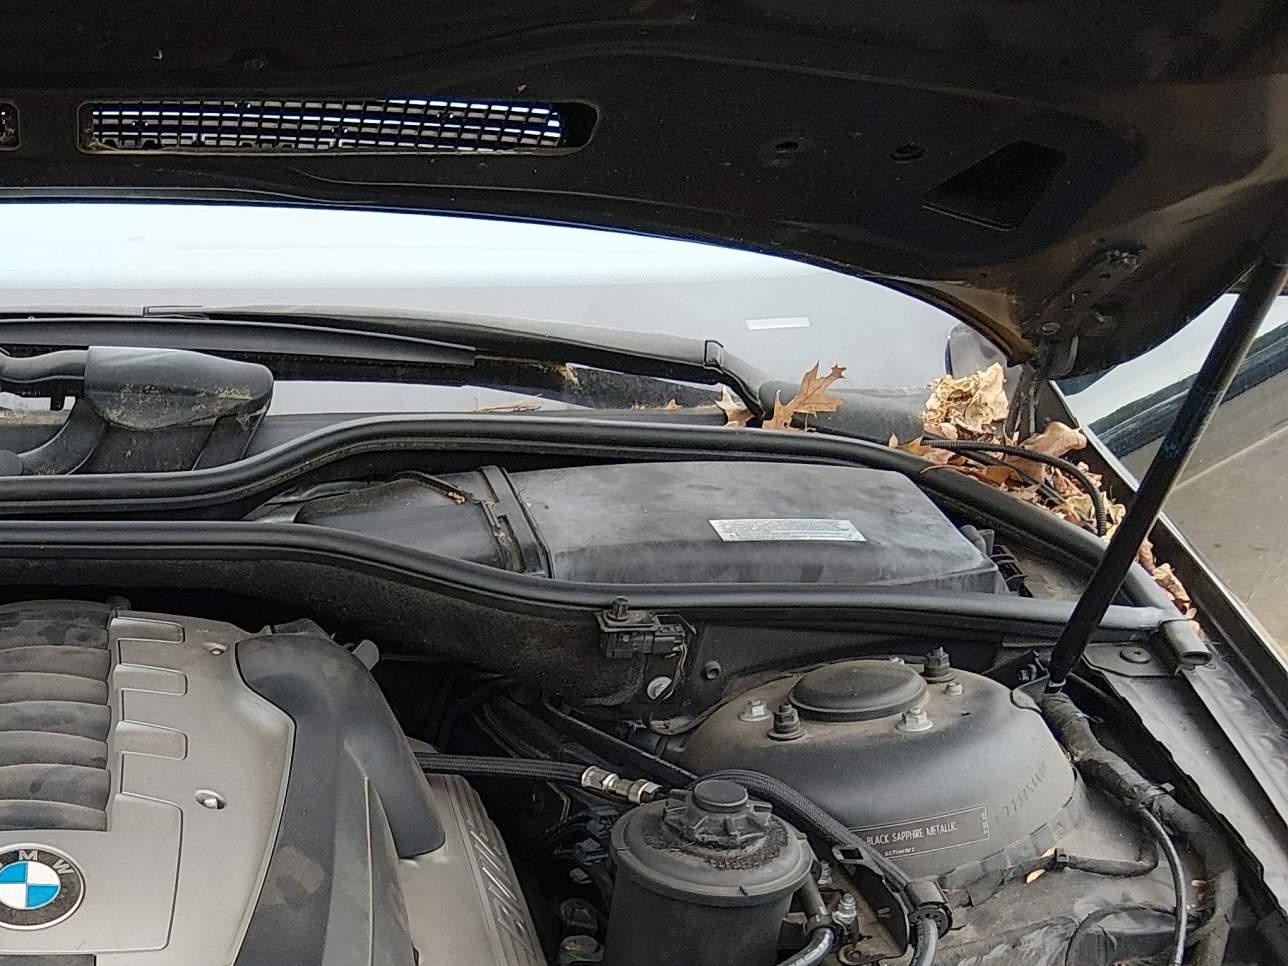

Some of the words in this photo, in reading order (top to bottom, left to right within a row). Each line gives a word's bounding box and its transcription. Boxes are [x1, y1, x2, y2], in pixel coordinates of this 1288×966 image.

[866, 832, 889, 847] BLACK
[892, 826, 924, 844] SAPPHIRE
[926, 821, 958, 837] METALLIC
